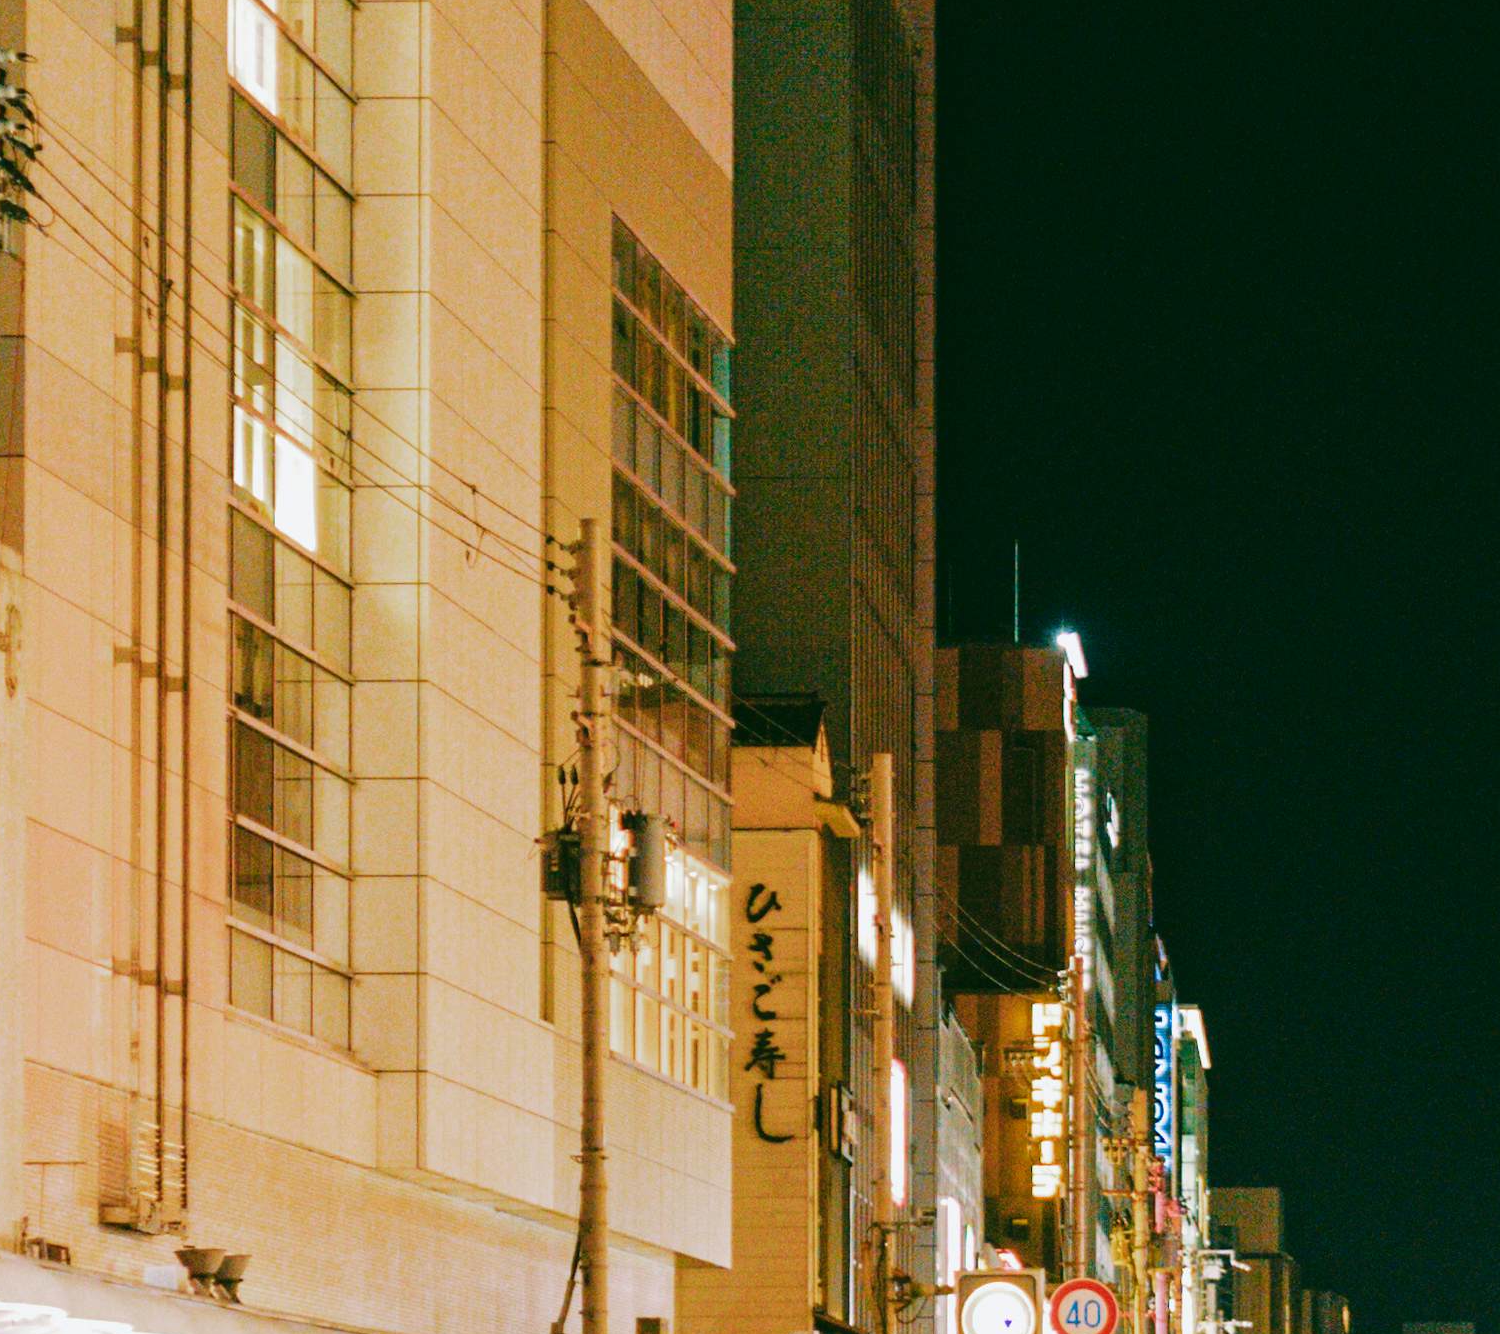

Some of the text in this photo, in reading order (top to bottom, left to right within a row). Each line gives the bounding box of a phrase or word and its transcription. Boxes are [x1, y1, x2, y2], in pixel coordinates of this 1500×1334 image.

[744, 883, 794, 1144] ひさご寿し
[1066, 1299, 1101, 1328] 40
